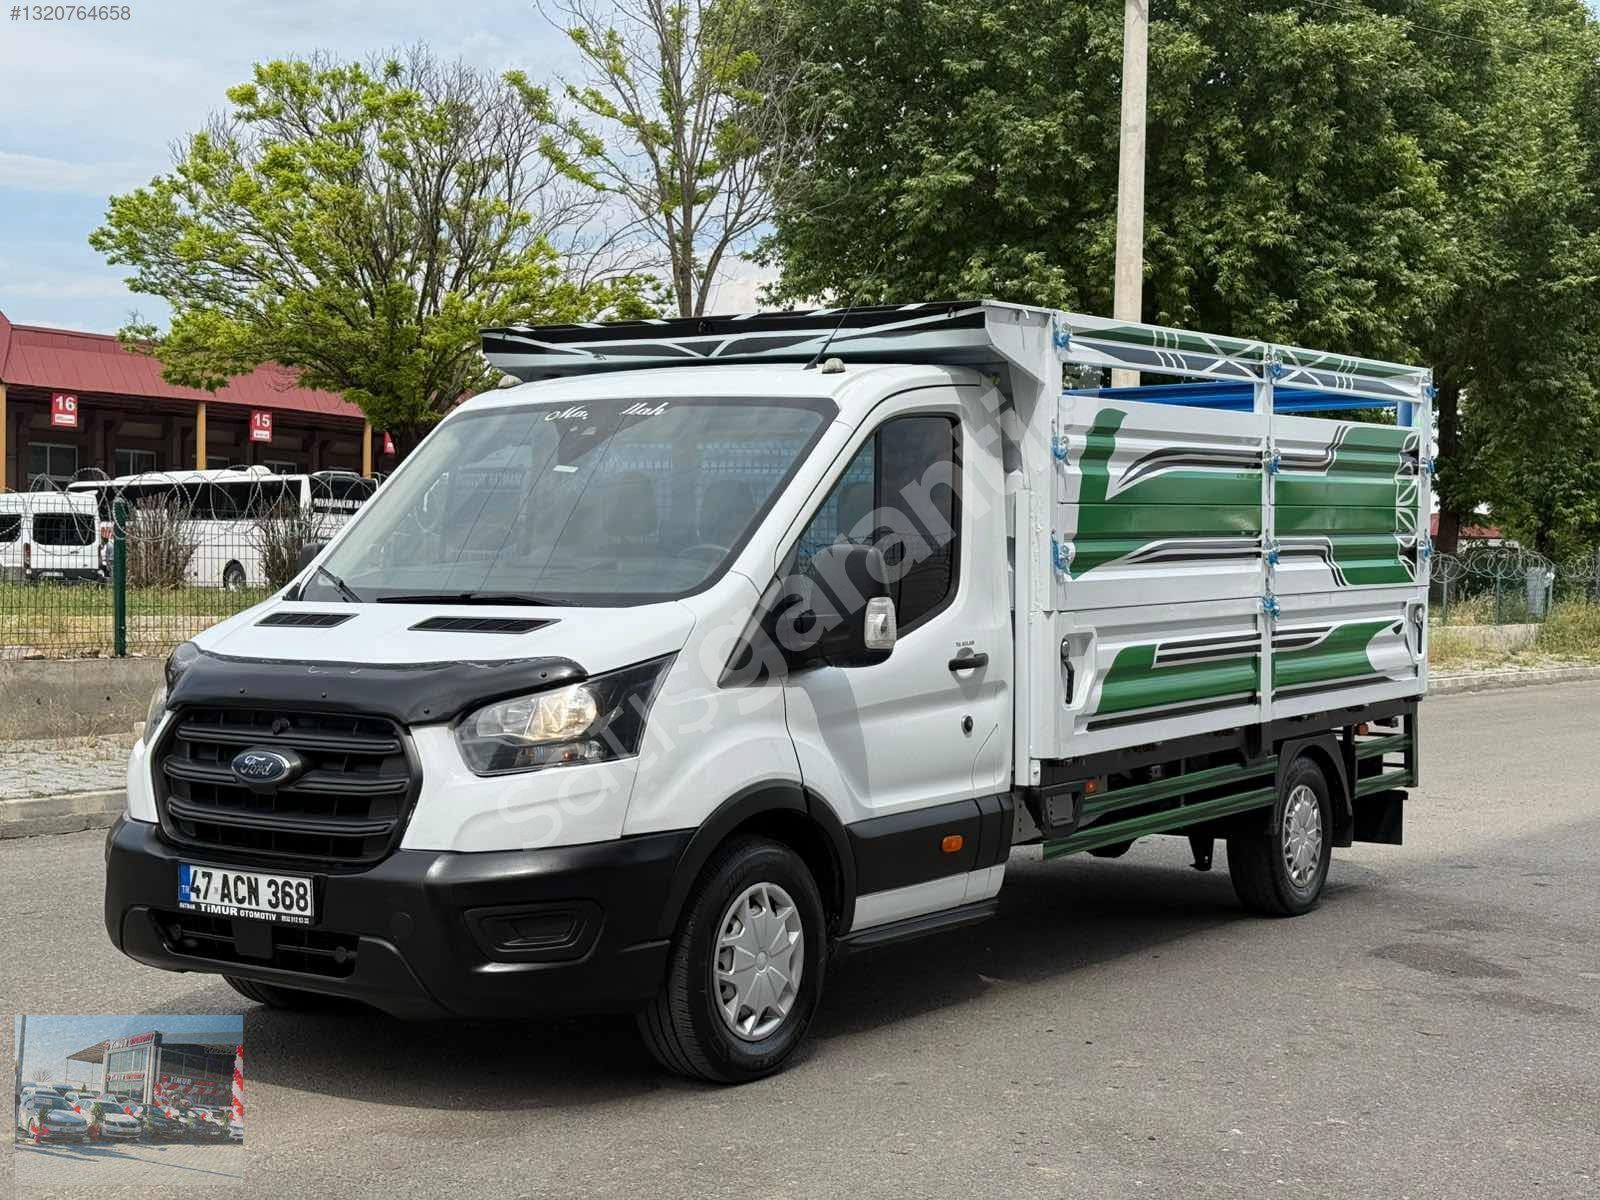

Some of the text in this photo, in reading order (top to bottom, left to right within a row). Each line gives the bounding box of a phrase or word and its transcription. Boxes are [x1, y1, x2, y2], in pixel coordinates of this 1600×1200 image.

[55, 395, 76, 411] 16
[254, 413, 271, 427] 15
[241, 754, 274, 776] Ford
[191, 869, 309, 912] 47 ACN 368
